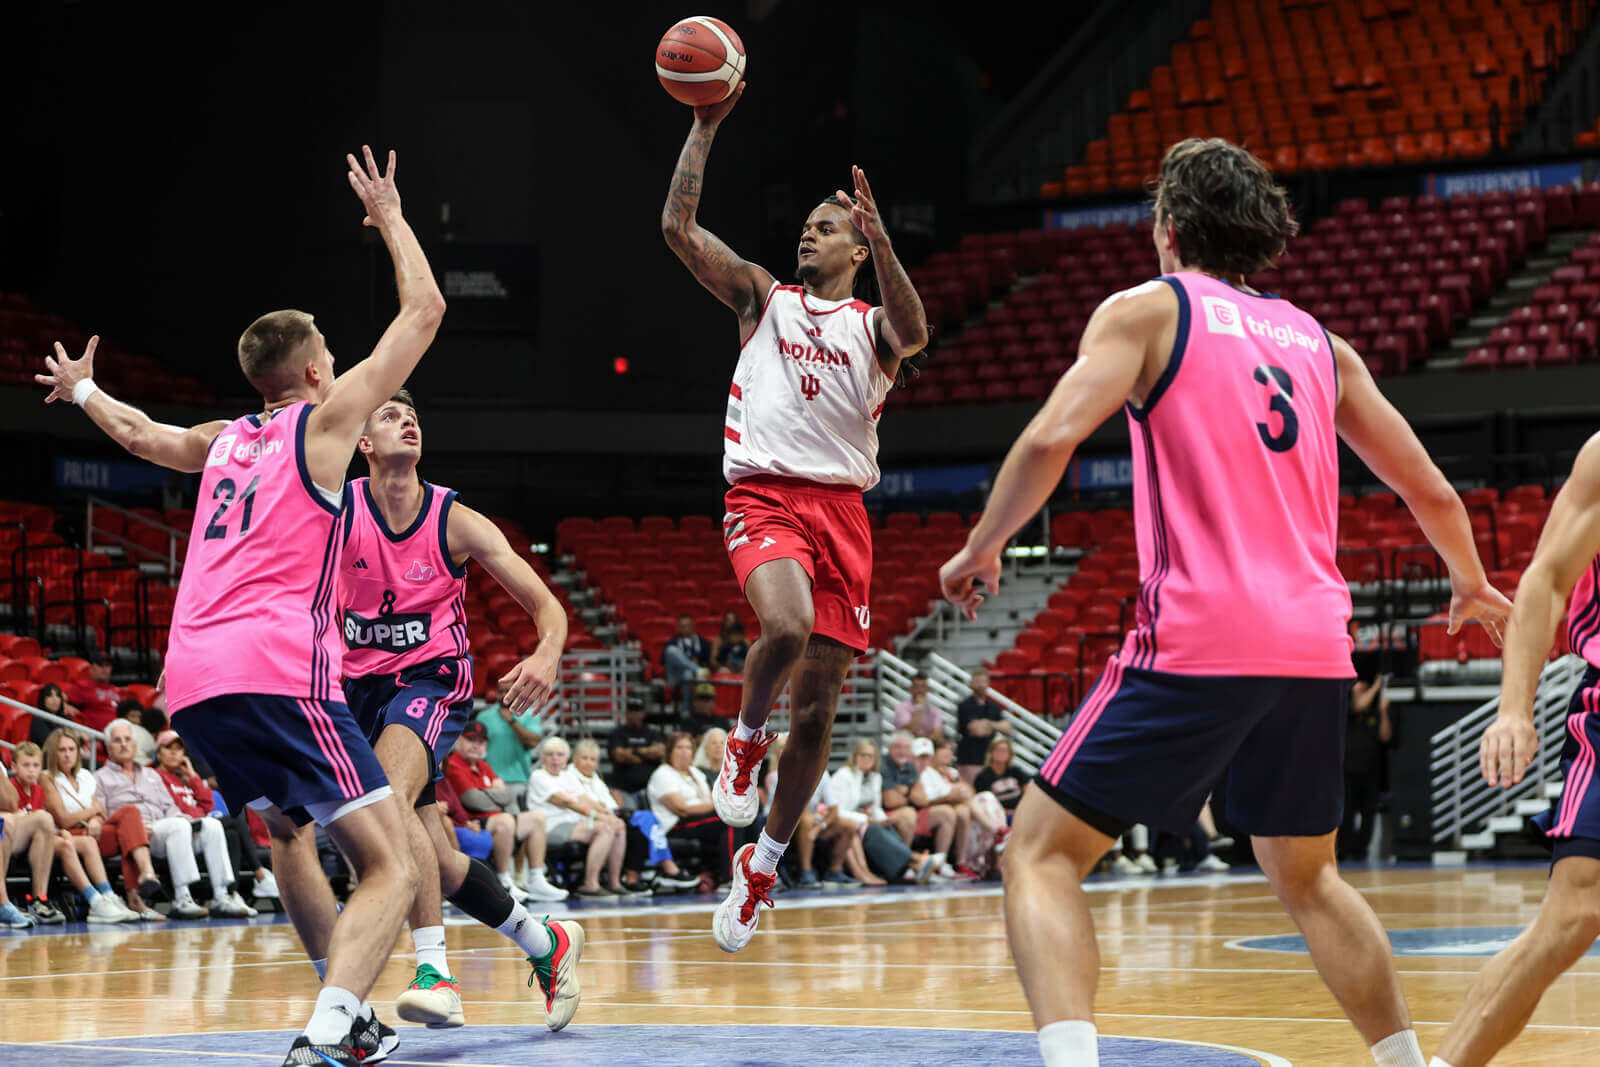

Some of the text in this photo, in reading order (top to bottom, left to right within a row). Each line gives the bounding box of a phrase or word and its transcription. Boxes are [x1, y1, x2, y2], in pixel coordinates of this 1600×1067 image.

[1246, 315, 1320, 353] triglav
[774, 337, 851, 367] NDIANA
[1254, 365, 1299, 453] 3
[204, 475, 261, 541] 21
[378, 589, 397, 616] 8
[344, 616, 426, 647] SUPER
[406, 697, 429, 719] 8
